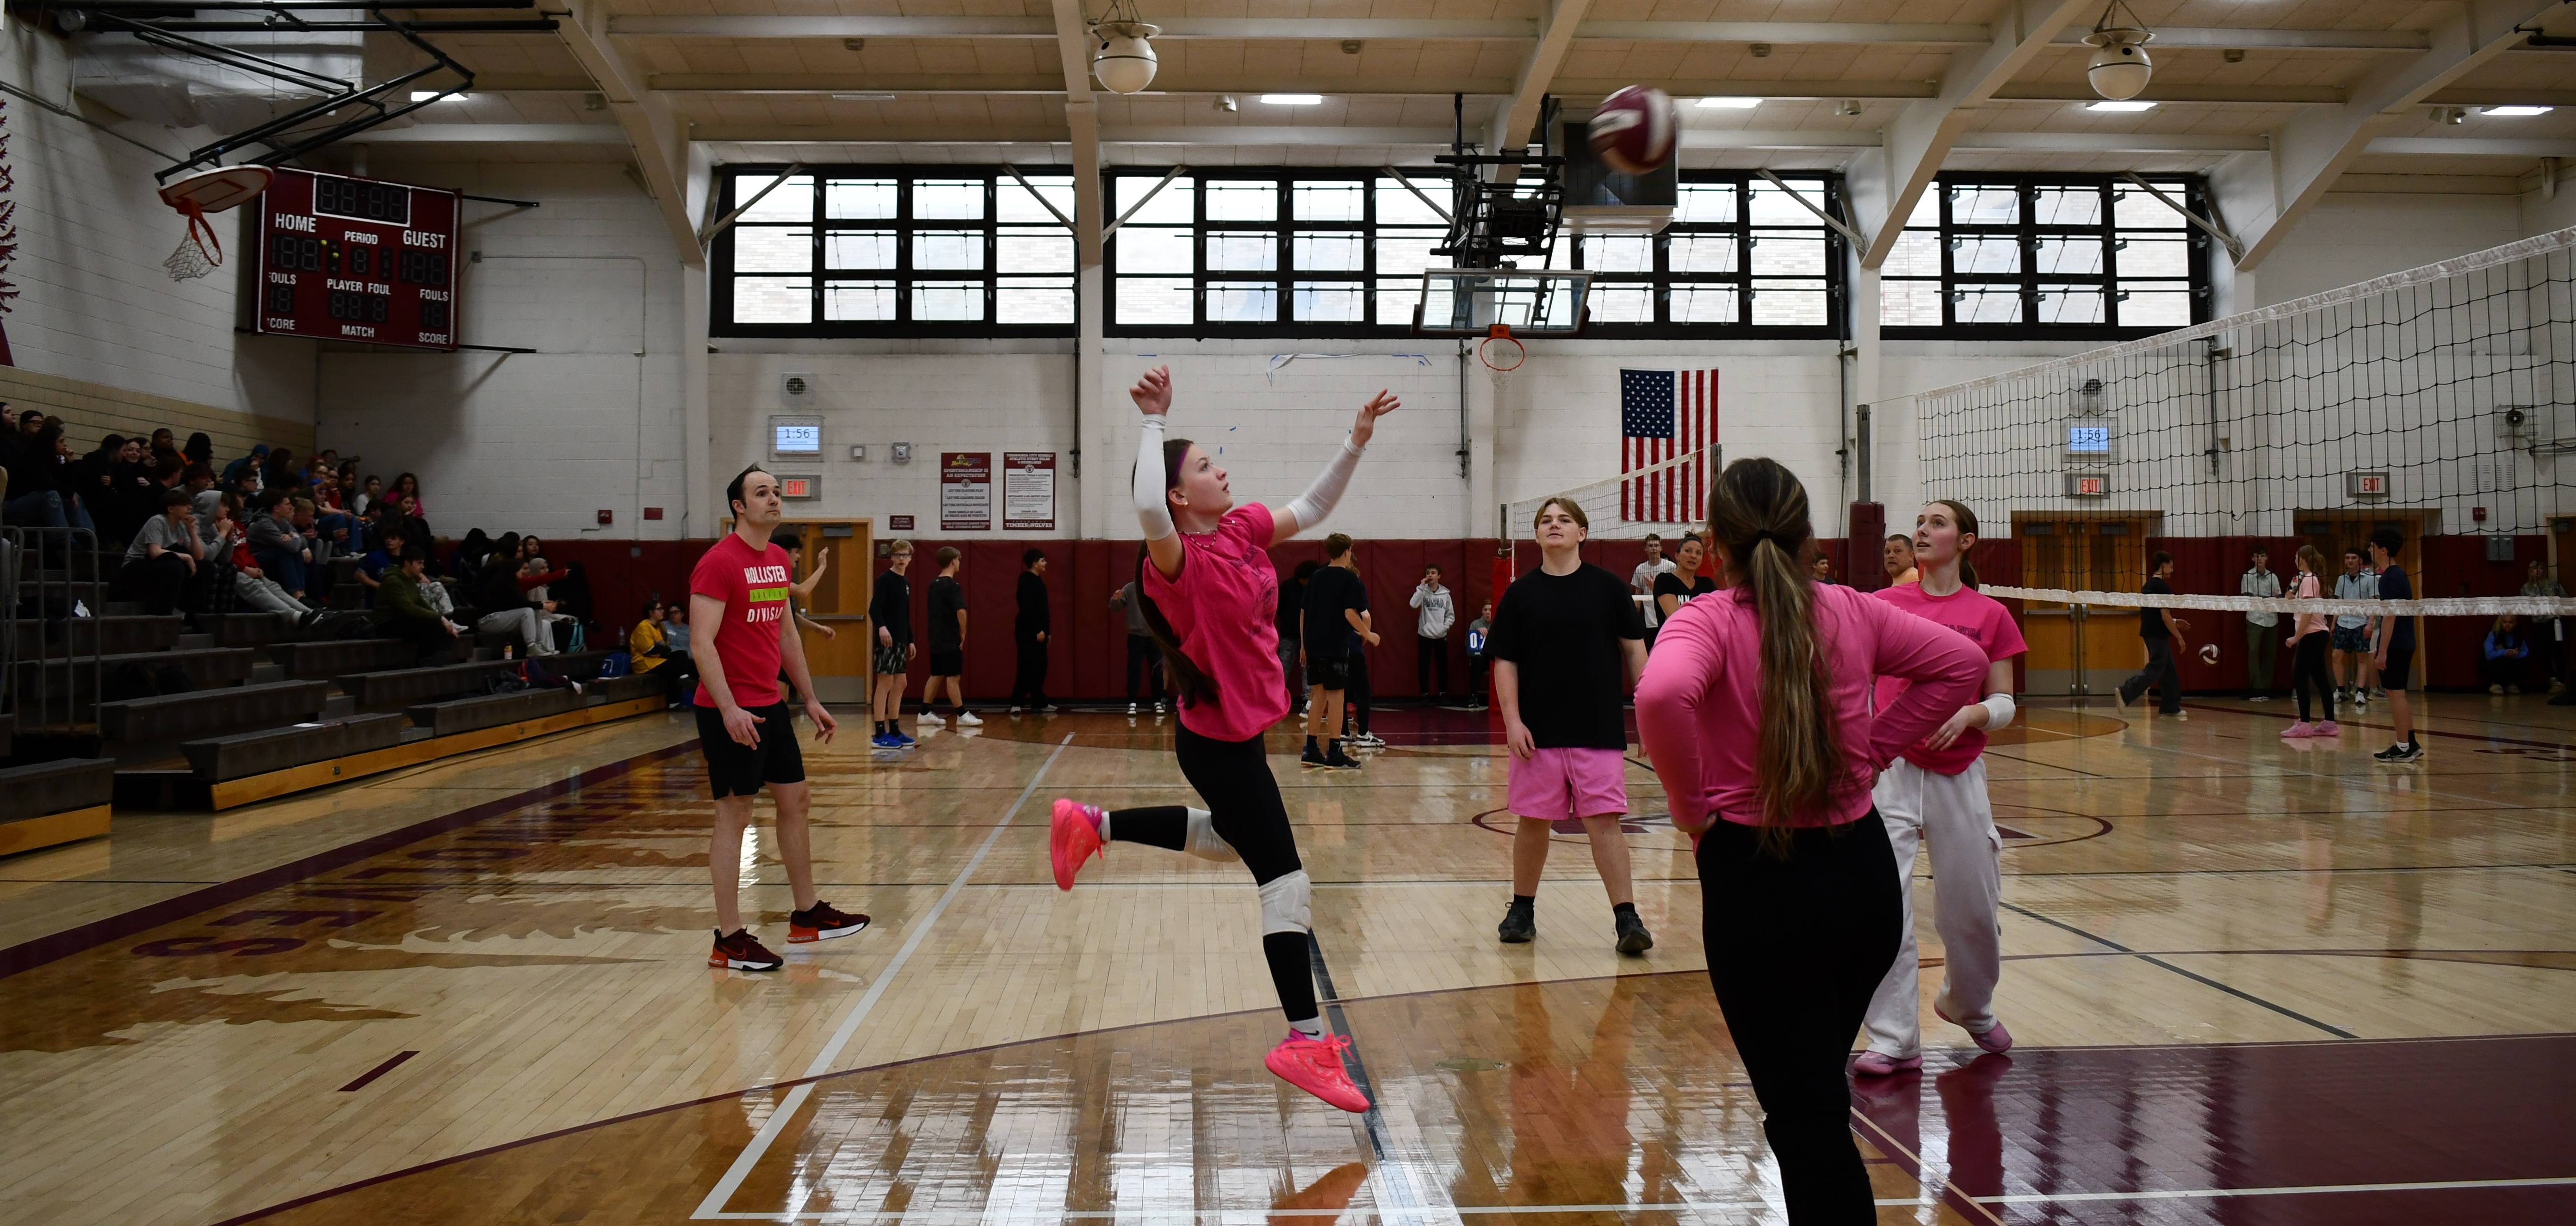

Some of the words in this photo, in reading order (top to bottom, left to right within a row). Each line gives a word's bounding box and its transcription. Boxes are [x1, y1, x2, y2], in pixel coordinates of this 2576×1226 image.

[275, 213, 316, 233] HOME
[345, 231, 378, 245] PERIOD
[403, 230, 446, 248] GUEST
[327, 278, 363, 292] PLAYER
[368, 283, 391, 295] FOUL
[420, 289, 449, 301] FOULS
[341, 325, 374, 338] MATCH
[418, 333, 447, 344] SCORE
[785, 429, 810, 438] 1:56
[2078, 430, 2100, 438] 1:56
[786, 481, 805, 495] EXIT
[2081, 479, 2099, 493] EXIT
[2363, 478, 2380, 491] EXIT
[744, 566, 787, 584] HOLLISTER
[747, 606, 783, 622] DIVISIO
